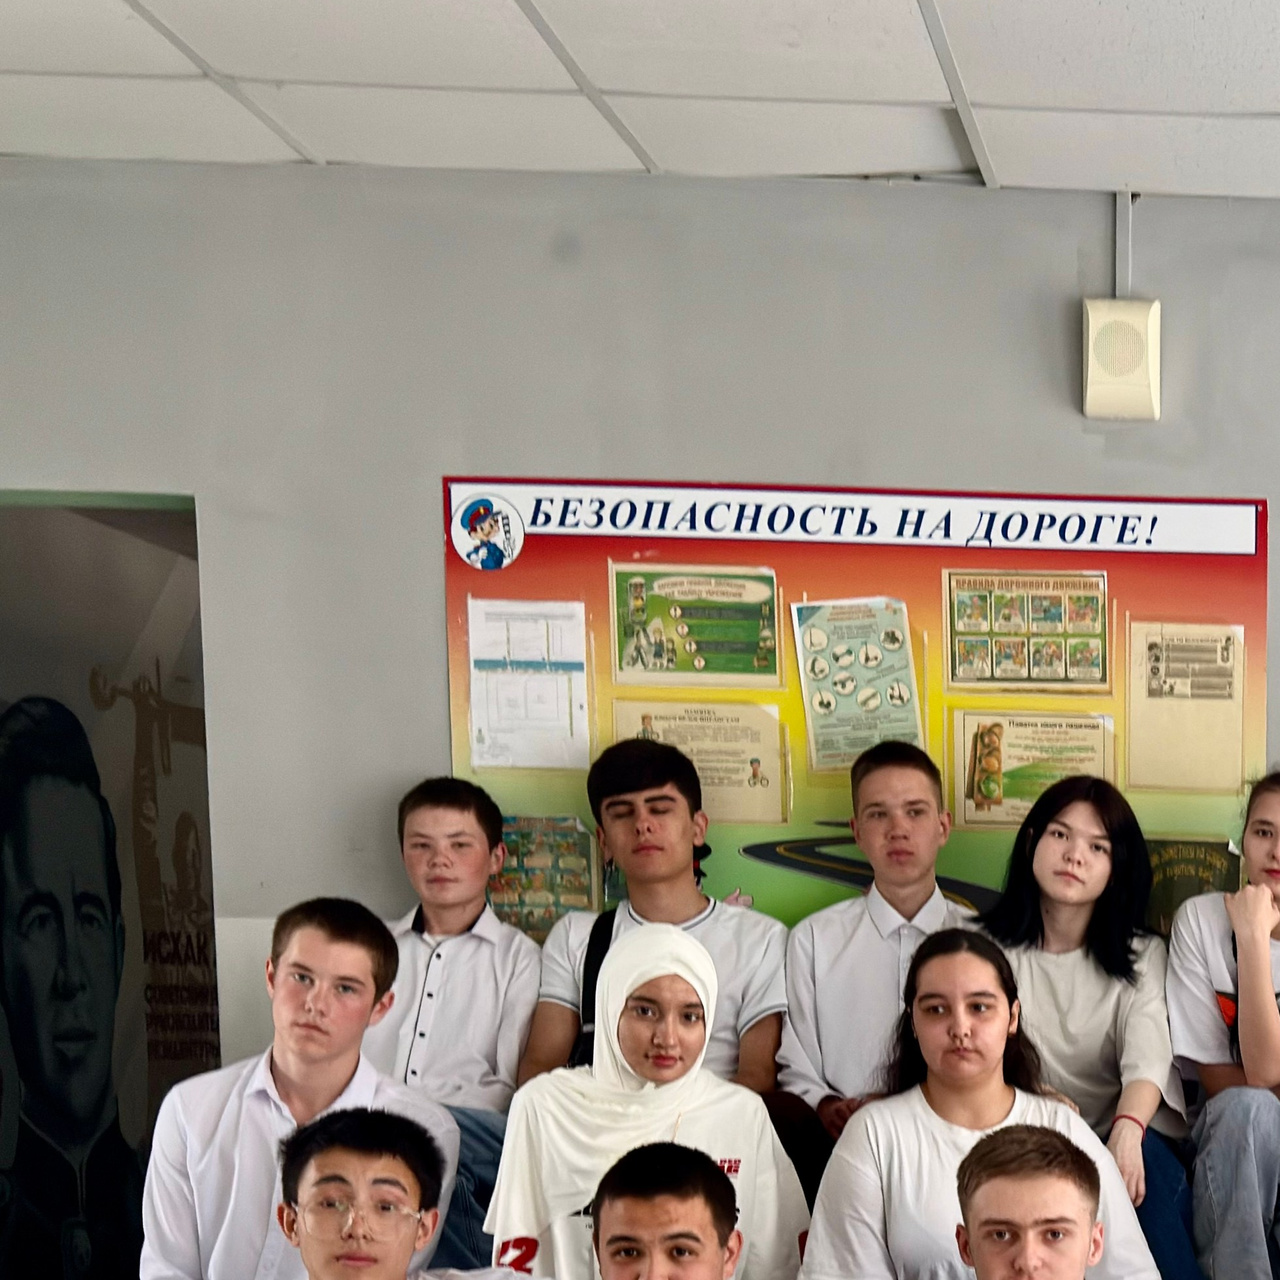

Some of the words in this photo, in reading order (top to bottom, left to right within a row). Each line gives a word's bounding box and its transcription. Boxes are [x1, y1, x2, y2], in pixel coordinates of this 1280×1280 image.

[529, 497, 878, 537] БЕЗОПАСНОСТЬ
[896, 508, 953, 539] НА
[964, 511, 1159, 548] ДОРОГЕ!
[955, 577, 995, 590] ПРАВИЛА
[997, 579, 1050, 591] ДОРОЖНОГО
[1052, 579, 1100, 591] ДВИЖЕНИЯ
